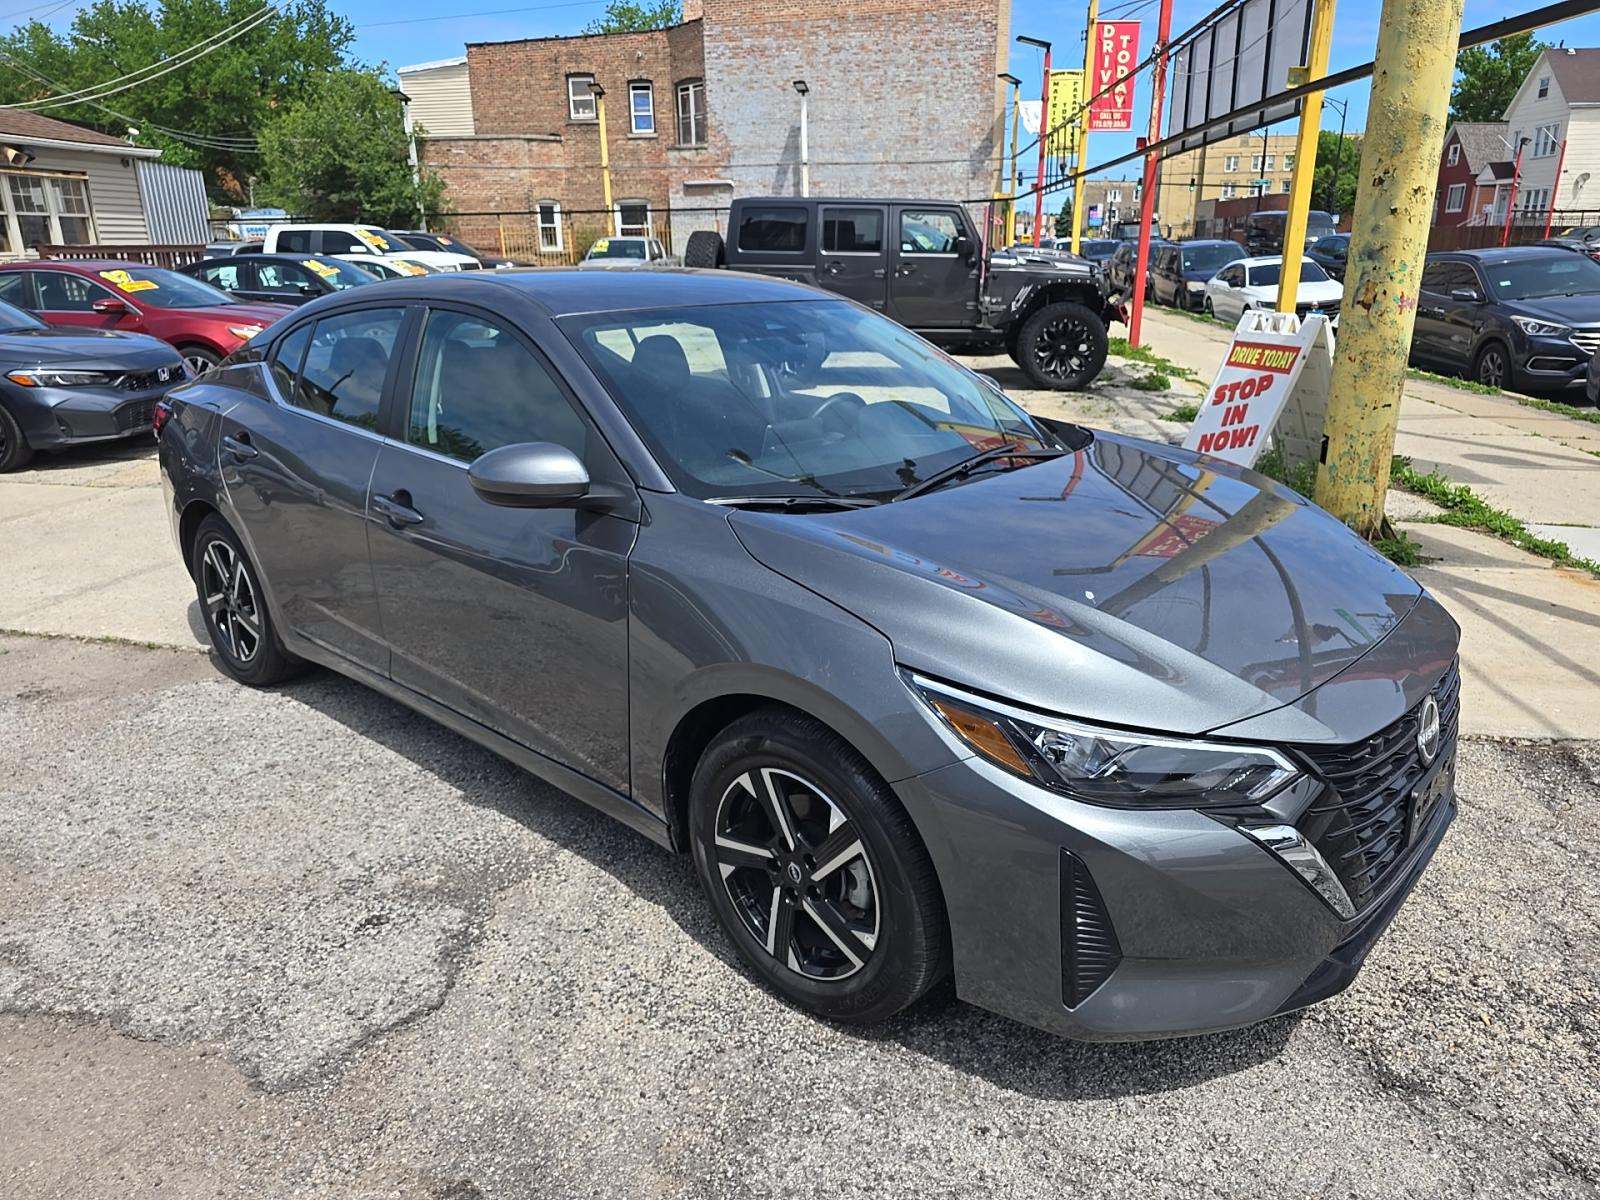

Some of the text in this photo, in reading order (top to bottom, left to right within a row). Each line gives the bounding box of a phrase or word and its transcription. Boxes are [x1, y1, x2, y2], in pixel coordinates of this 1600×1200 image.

[1100, 24, 1115, 98] DRIVE
[1114, 34, 1131, 108] TODAY
[1230, 346, 1297, 369] DRIVE TODAY
[1212, 374, 1274, 406] STOP
[1221, 403, 1249, 427] IN
[1197, 424, 1259, 452] NOW!
